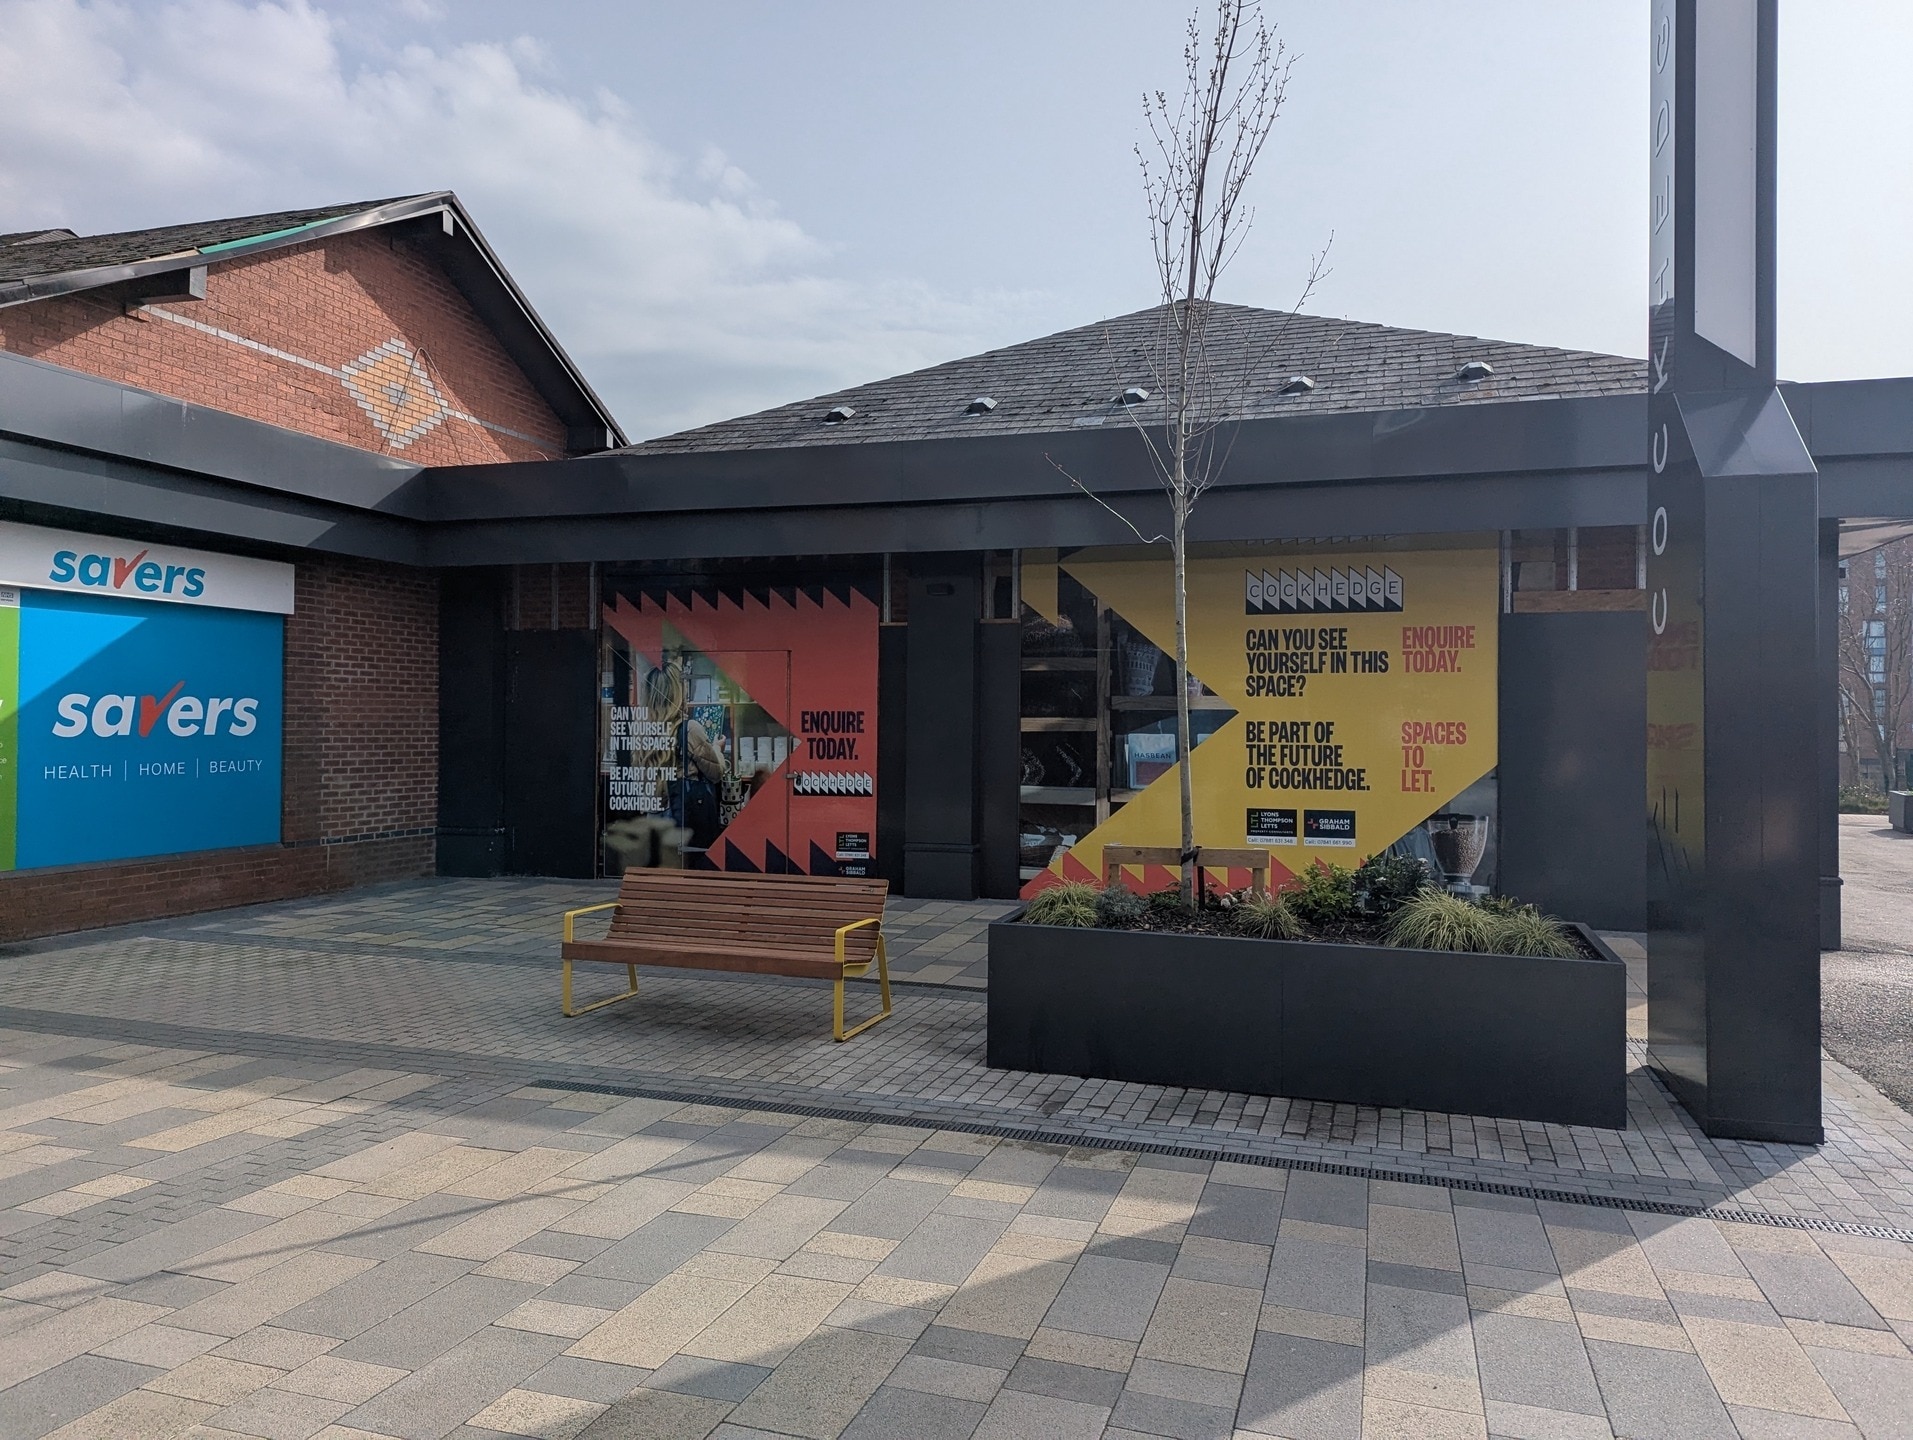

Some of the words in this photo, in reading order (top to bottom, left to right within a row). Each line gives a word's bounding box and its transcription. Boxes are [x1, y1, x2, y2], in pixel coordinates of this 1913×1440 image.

[49, 549, 206, 598] savers
[1249, 580, 1399, 598] COCKHEDGE
[1246, 628, 1279, 651] CAN
[1282, 628, 1315, 651] YOU
[1318, 628, 1348, 650] SEE
[1402, 625, 1476, 650] ENQUIRE
[1246, 651, 1327, 674] YOURSELF
[1330, 651, 1347, 673] IN
[1350, 651, 1389, 673] THIS
[1402, 650, 1462, 673] TODAY.
[1246, 675, 1307, 697] SPACE?
[52, 680, 259, 738] savers
[610, 706, 629, 720] CAN
[630, 706, 648, 720] YOU
[610, 721, 627, 736] SEE
[628, 721, 673, 736] YOURSELF
[801, 710, 865, 735] ENQUIRE
[1246, 721, 1266, 743] BE
[1269, 721, 1311, 743] PART
[1314, 721, 1335, 743] OF
[1401, 721, 1467, 745] SPACES
[610, 736, 620, 751] IN
[620, 736, 641, 751] THIS
[642, 736, 676, 751] SPACE?
[806, 738, 859, 761] TODAY.
[1246, 744, 1277, 766] THE
[1280, 744, 1344, 767] FUTURE
[1401, 745, 1425, 768] TO
[44, 764, 113, 780] HEALTH
[139, 761, 186, 777] HOME
[209, 758, 263, 775] BEAUTY
[609, 766, 621, 780] BE
[622, 766, 646, 781] PART
[646, 766, 658, 781] OF
[659, 766, 678, 781] THE
[1246, 767, 1266, 789] OF
[1268, 767, 1371, 791] COCKHEDGE.
[609, 781, 644, 796] FUTURE
[645, 781, 657, 796] OF
[1401, 769, 1436, 793] LET.
[609, 796, 665, 811] COCKHEDGE.
[1319, 823, 1351, 831] SIBBALD
